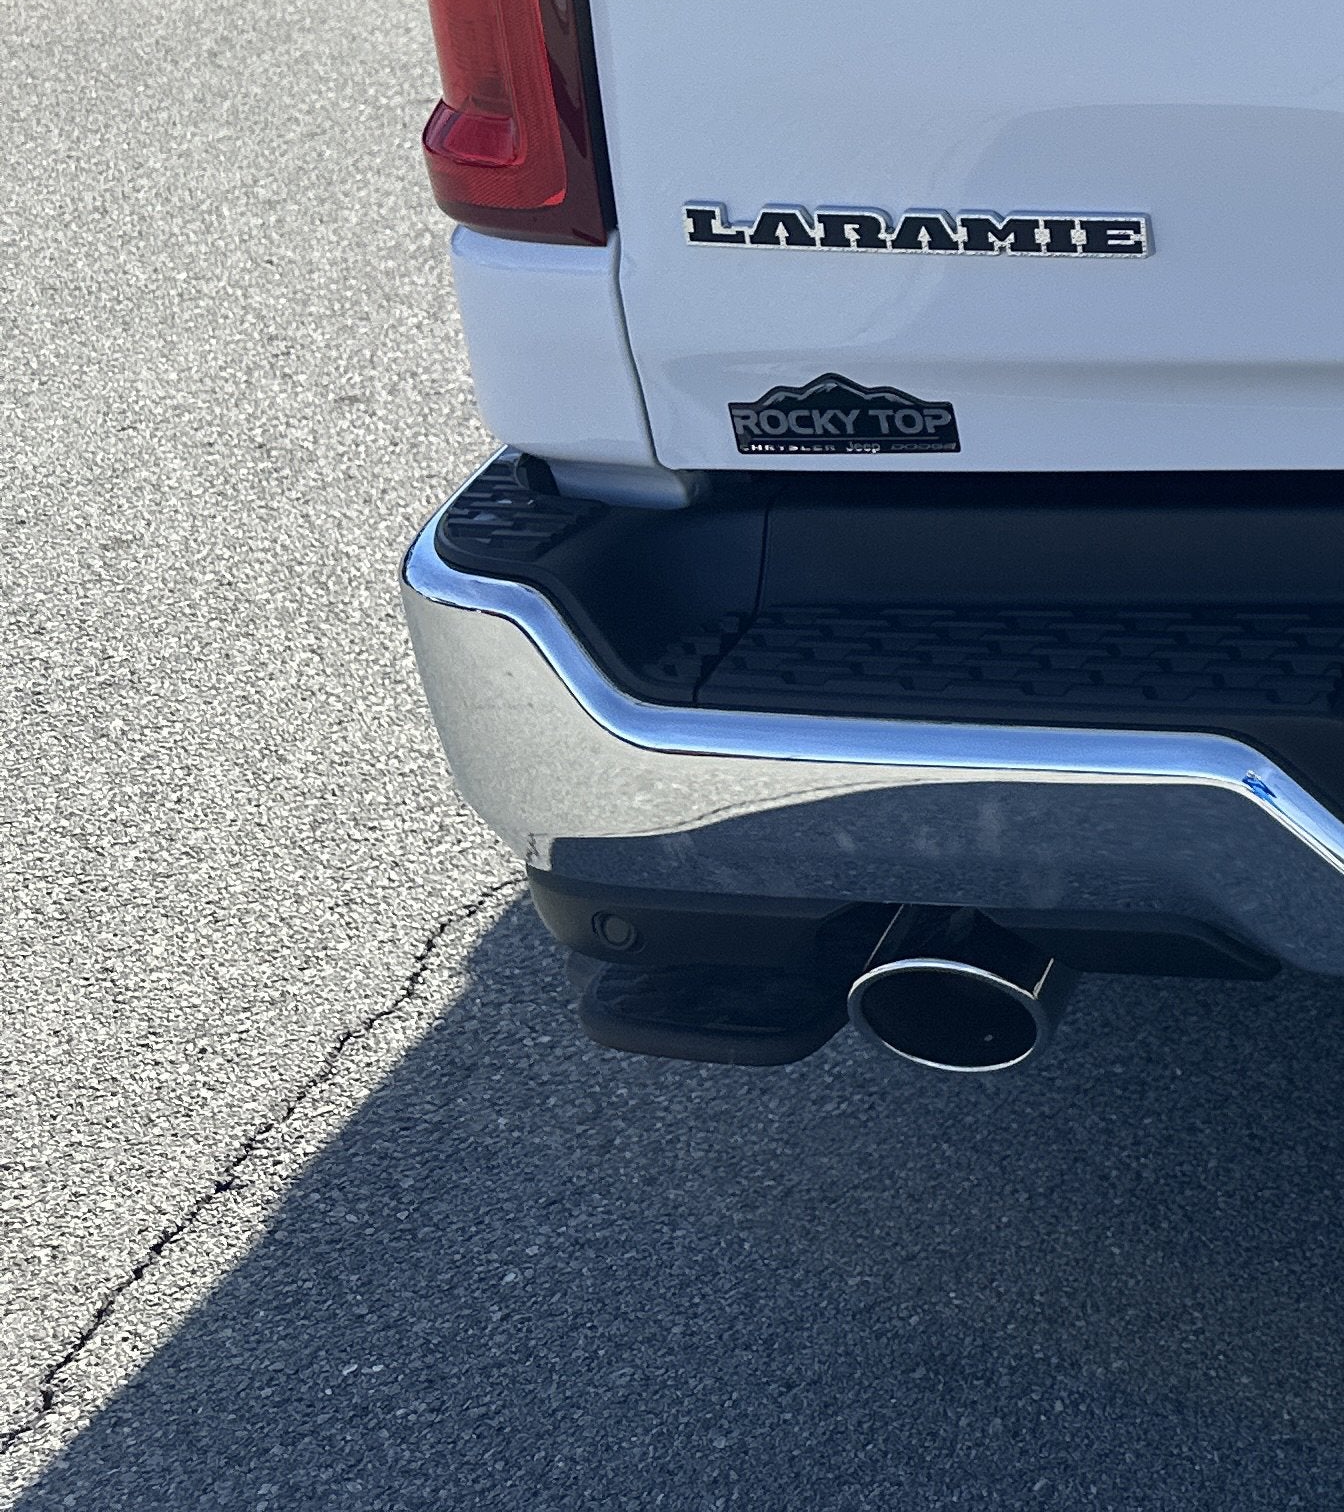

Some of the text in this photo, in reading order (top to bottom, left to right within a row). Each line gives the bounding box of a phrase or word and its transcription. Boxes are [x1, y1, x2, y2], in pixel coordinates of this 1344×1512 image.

[683, 200, 1151, 258] LARAMIE
[731, 408, 952, 435] ROCKY TOP
[739, 441, 957, 453] CHRYSLER Jeep DODGE
